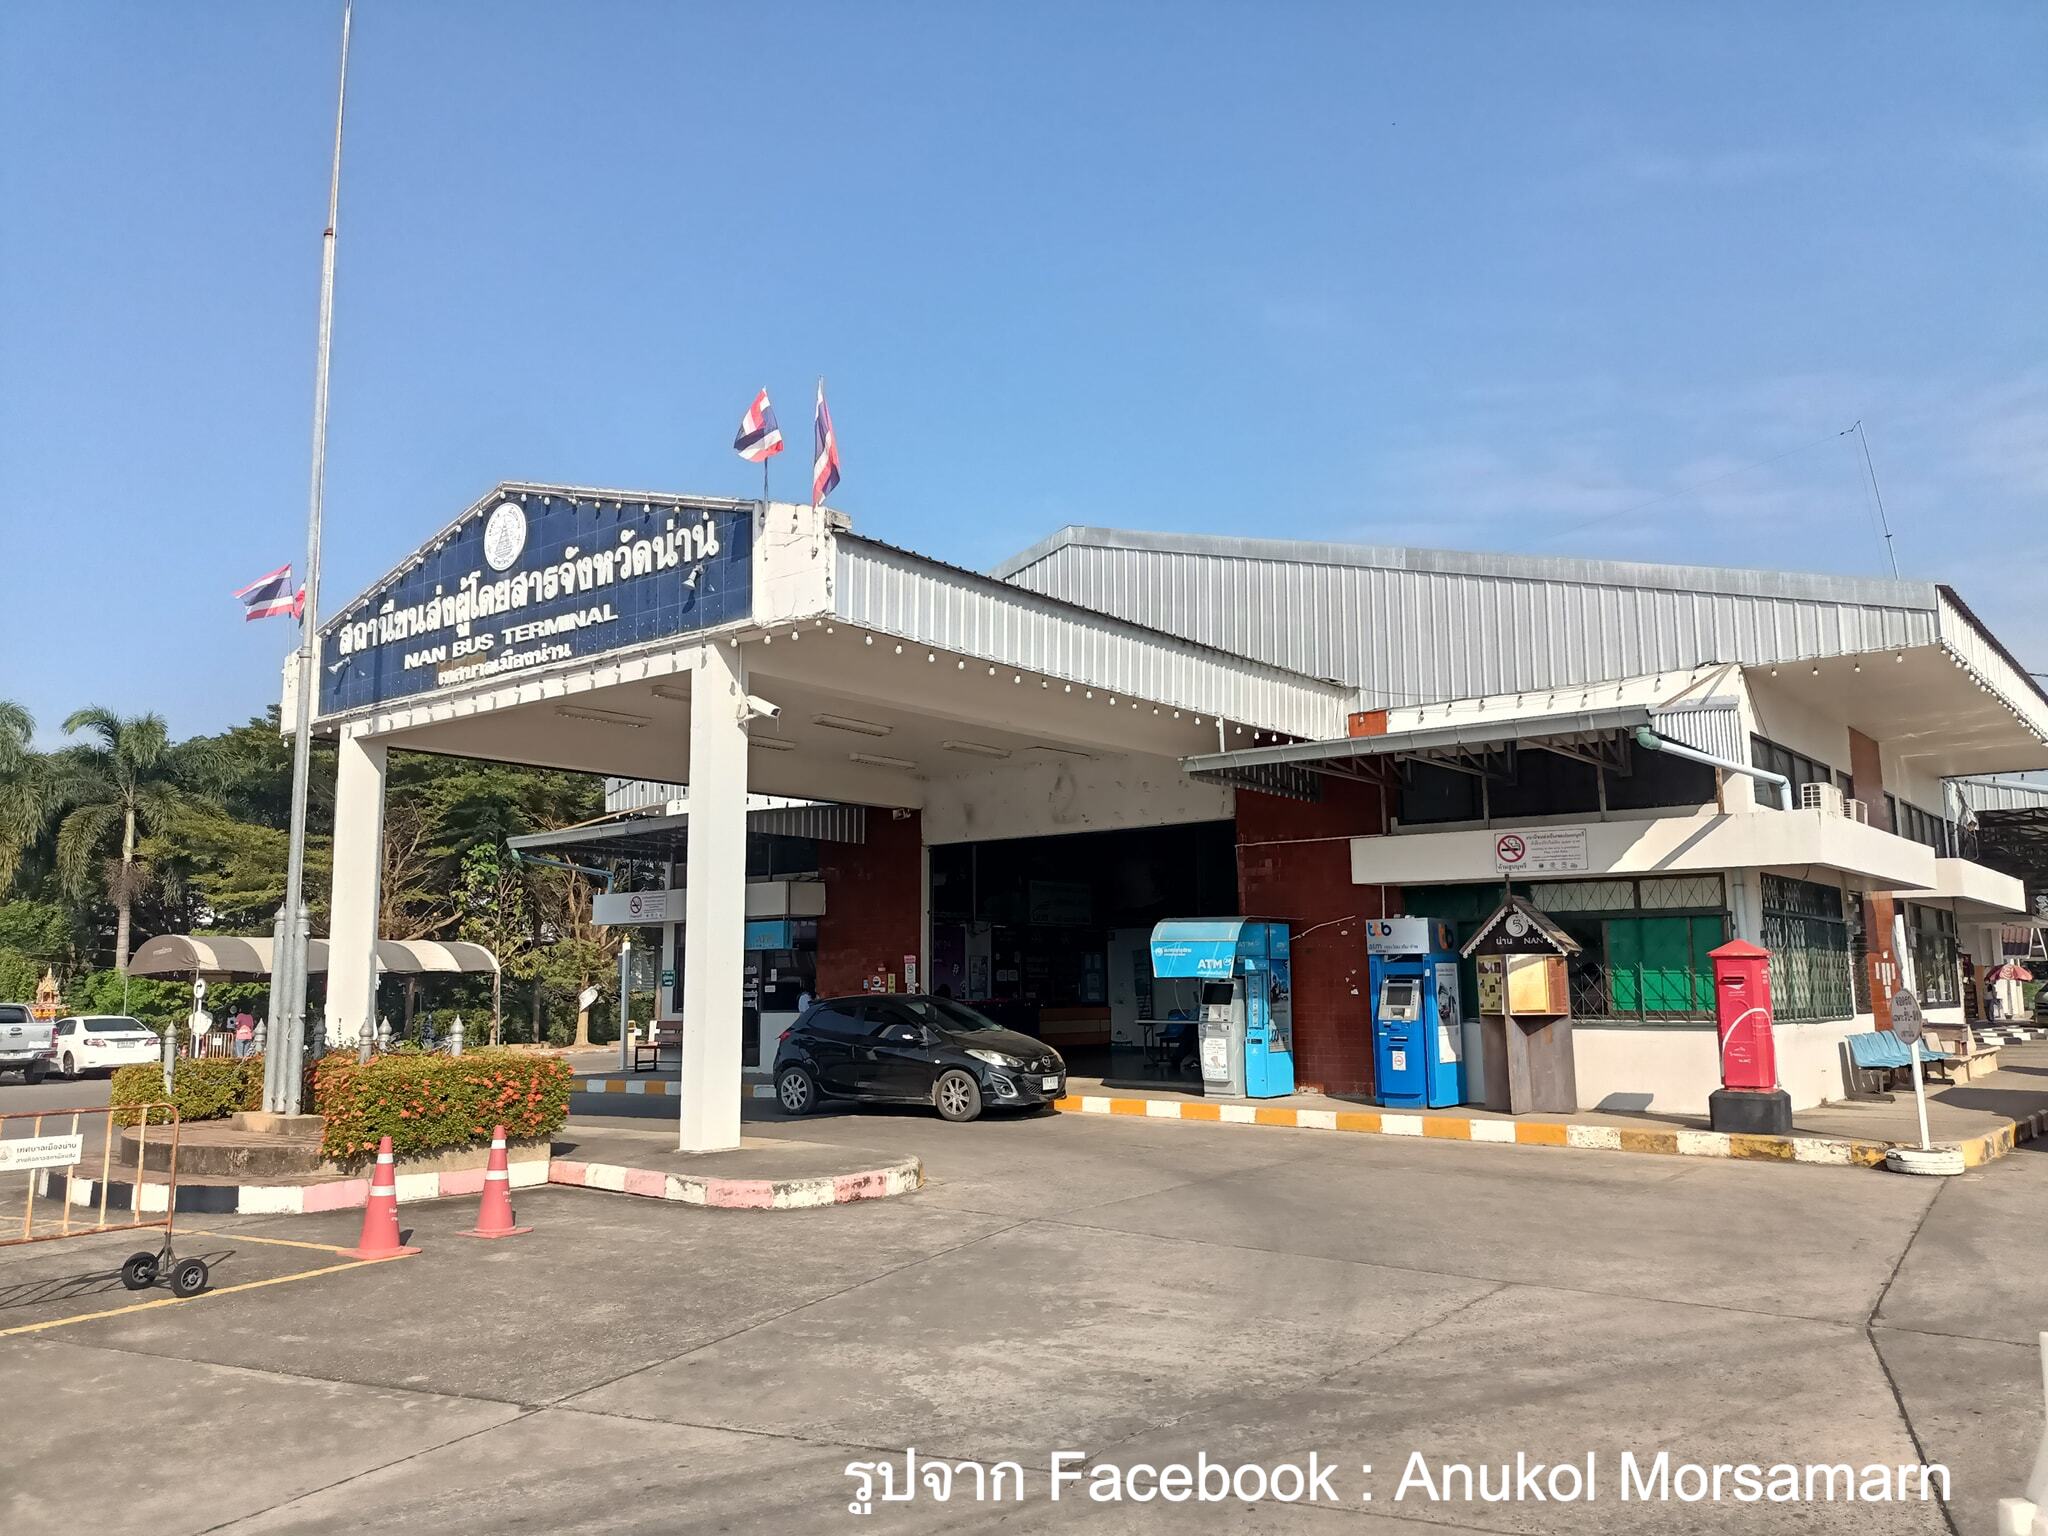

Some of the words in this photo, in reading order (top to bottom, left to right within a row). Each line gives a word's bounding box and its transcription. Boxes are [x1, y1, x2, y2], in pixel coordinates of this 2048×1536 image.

[338, 519, 720, 656] สถานีขนส่งผู้โดยสารจังหวัดน่าน
[404, 646, 447, 671] NAN
[452, 633, 494, 660] BUS
[501, 604, 620, 645] TERMINAL
[1367, 921, 1392, 937] ttb
[1523, 937, 1544, 945] NAN
[1197, 959, 1223, 969] ATM
